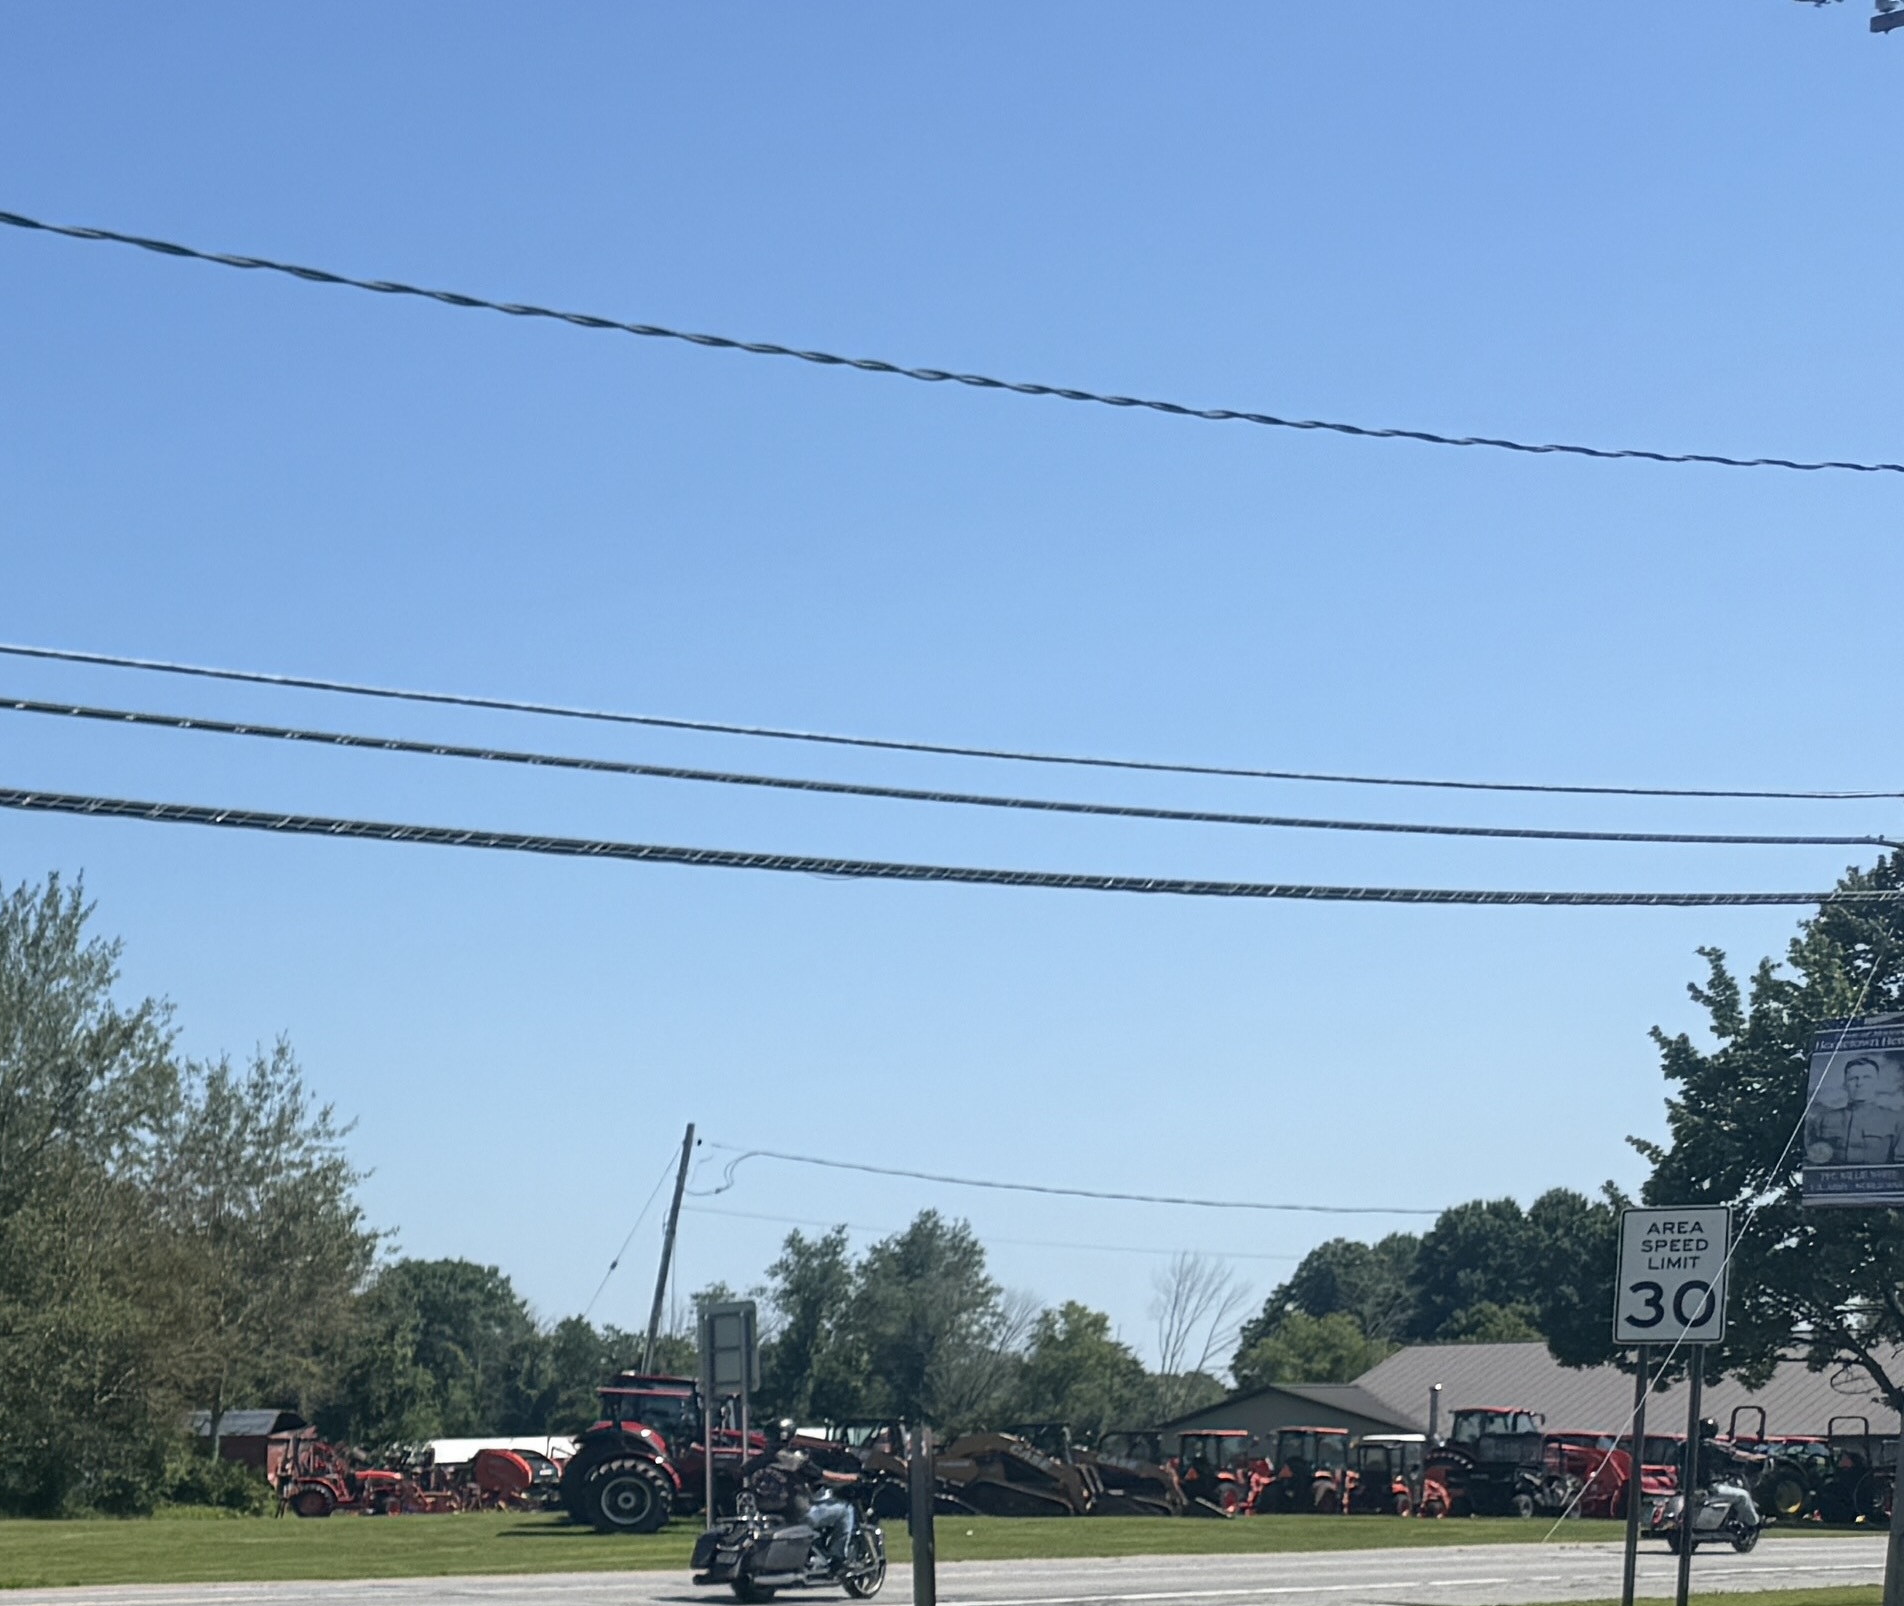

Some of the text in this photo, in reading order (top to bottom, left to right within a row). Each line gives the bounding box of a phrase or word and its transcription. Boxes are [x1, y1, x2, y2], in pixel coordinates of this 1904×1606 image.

[1647, 1221, 1704, 1235] AREA
[1641, 1239, 1709, 1253] SPEED
[1648, 1256, 1701, 1270] LIMIT
[1624, 1280, 1716, 1329] 30
